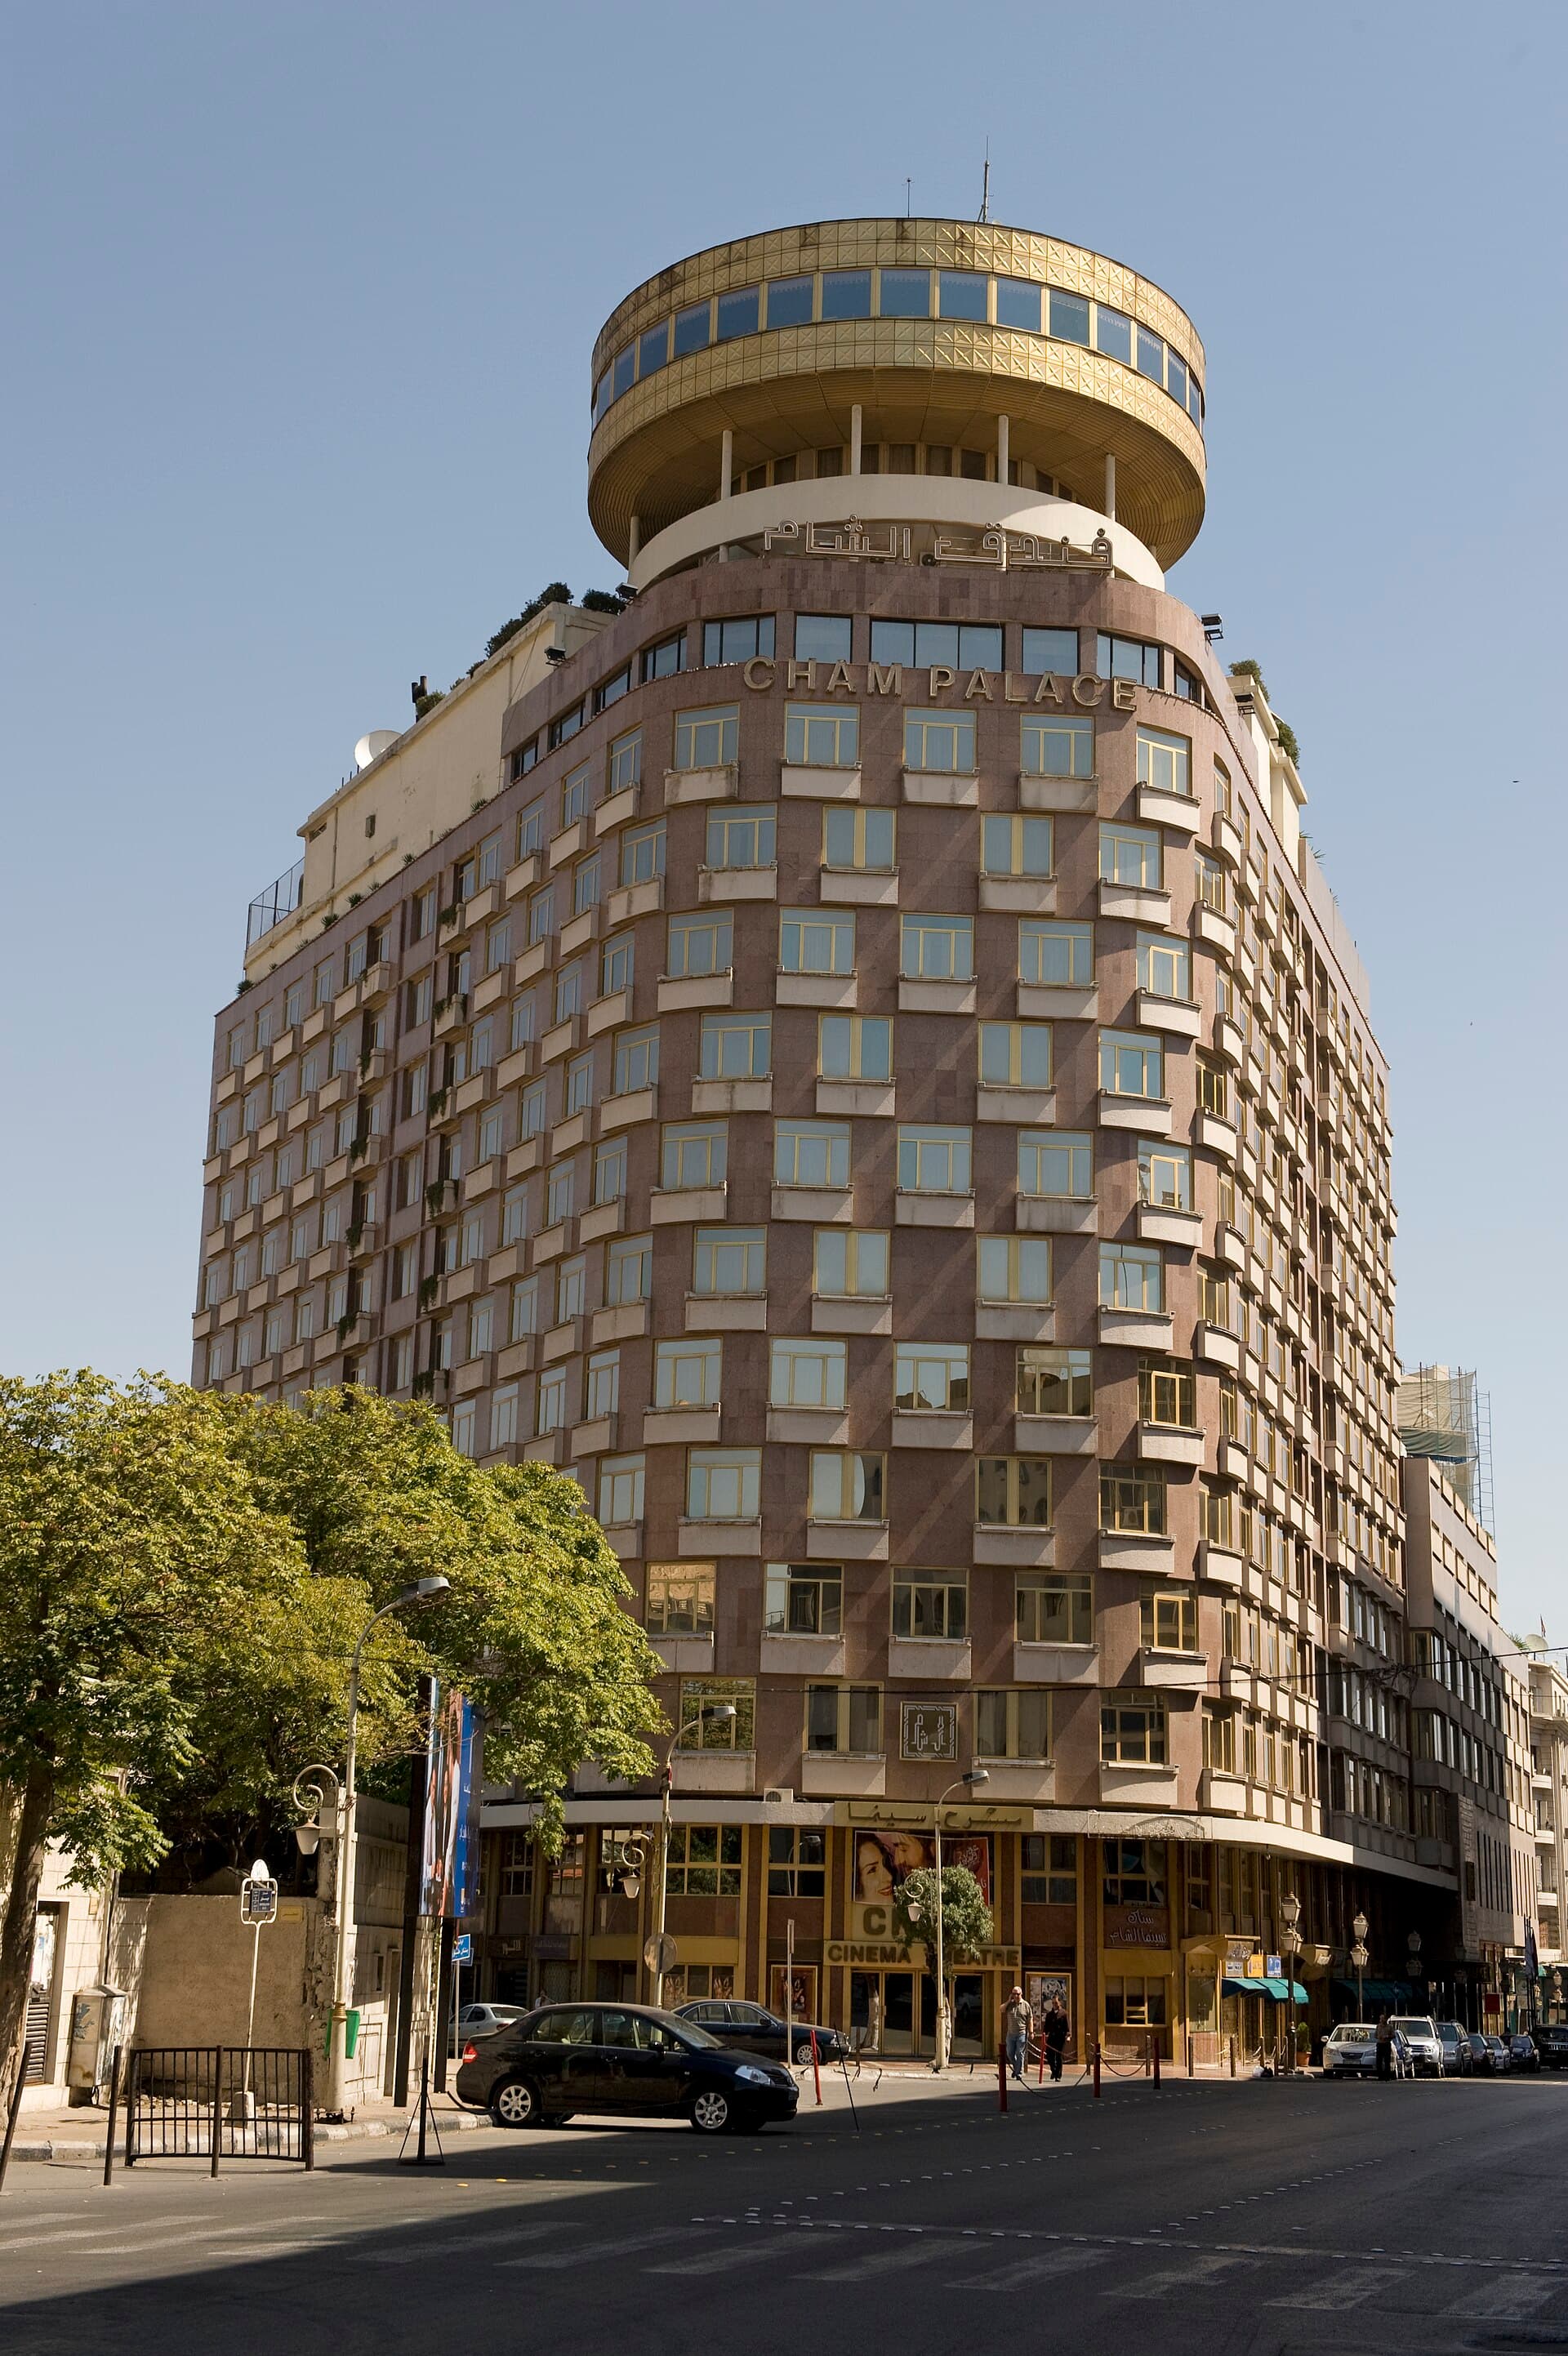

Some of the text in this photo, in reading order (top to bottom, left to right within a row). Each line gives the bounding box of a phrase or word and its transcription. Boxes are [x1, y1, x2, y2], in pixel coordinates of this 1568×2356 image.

[764, 514, 1113, 569] فندق الشام
[742, 655, 1138, 711] CHAM PALACE
[848, 1802, 926, 1826] سينما
[1110, 1926, 1168, 1947] سينما الشام
[827, 1944, 1020, 1966] CINEMA EATRE
